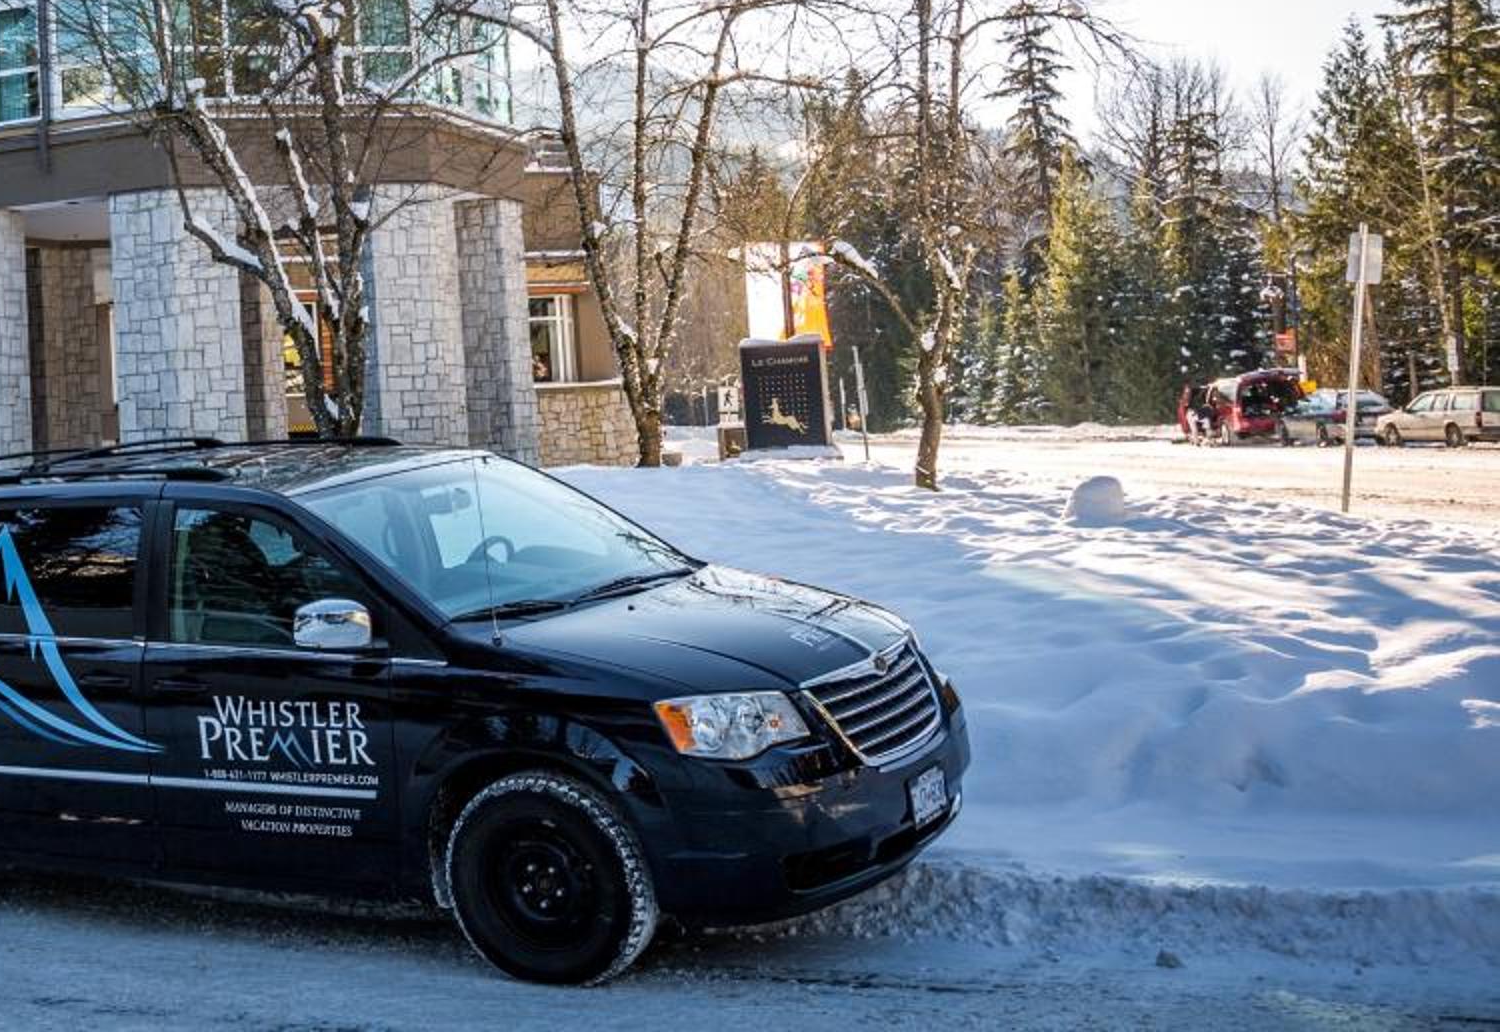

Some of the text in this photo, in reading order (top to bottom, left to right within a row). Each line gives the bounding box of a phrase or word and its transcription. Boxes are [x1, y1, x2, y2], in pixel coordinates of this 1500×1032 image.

[213, 696, 365, 728] WHISTLER
[197, 716, 376, 767] PREMIER
[270, 771, 379, 785] WHISTLERPREMIER.COM
[225, 801, 361, 820] MANAGERS OF DISTINCTIVE
[241, 819, 353, 837] VACATION PROPERTIES
